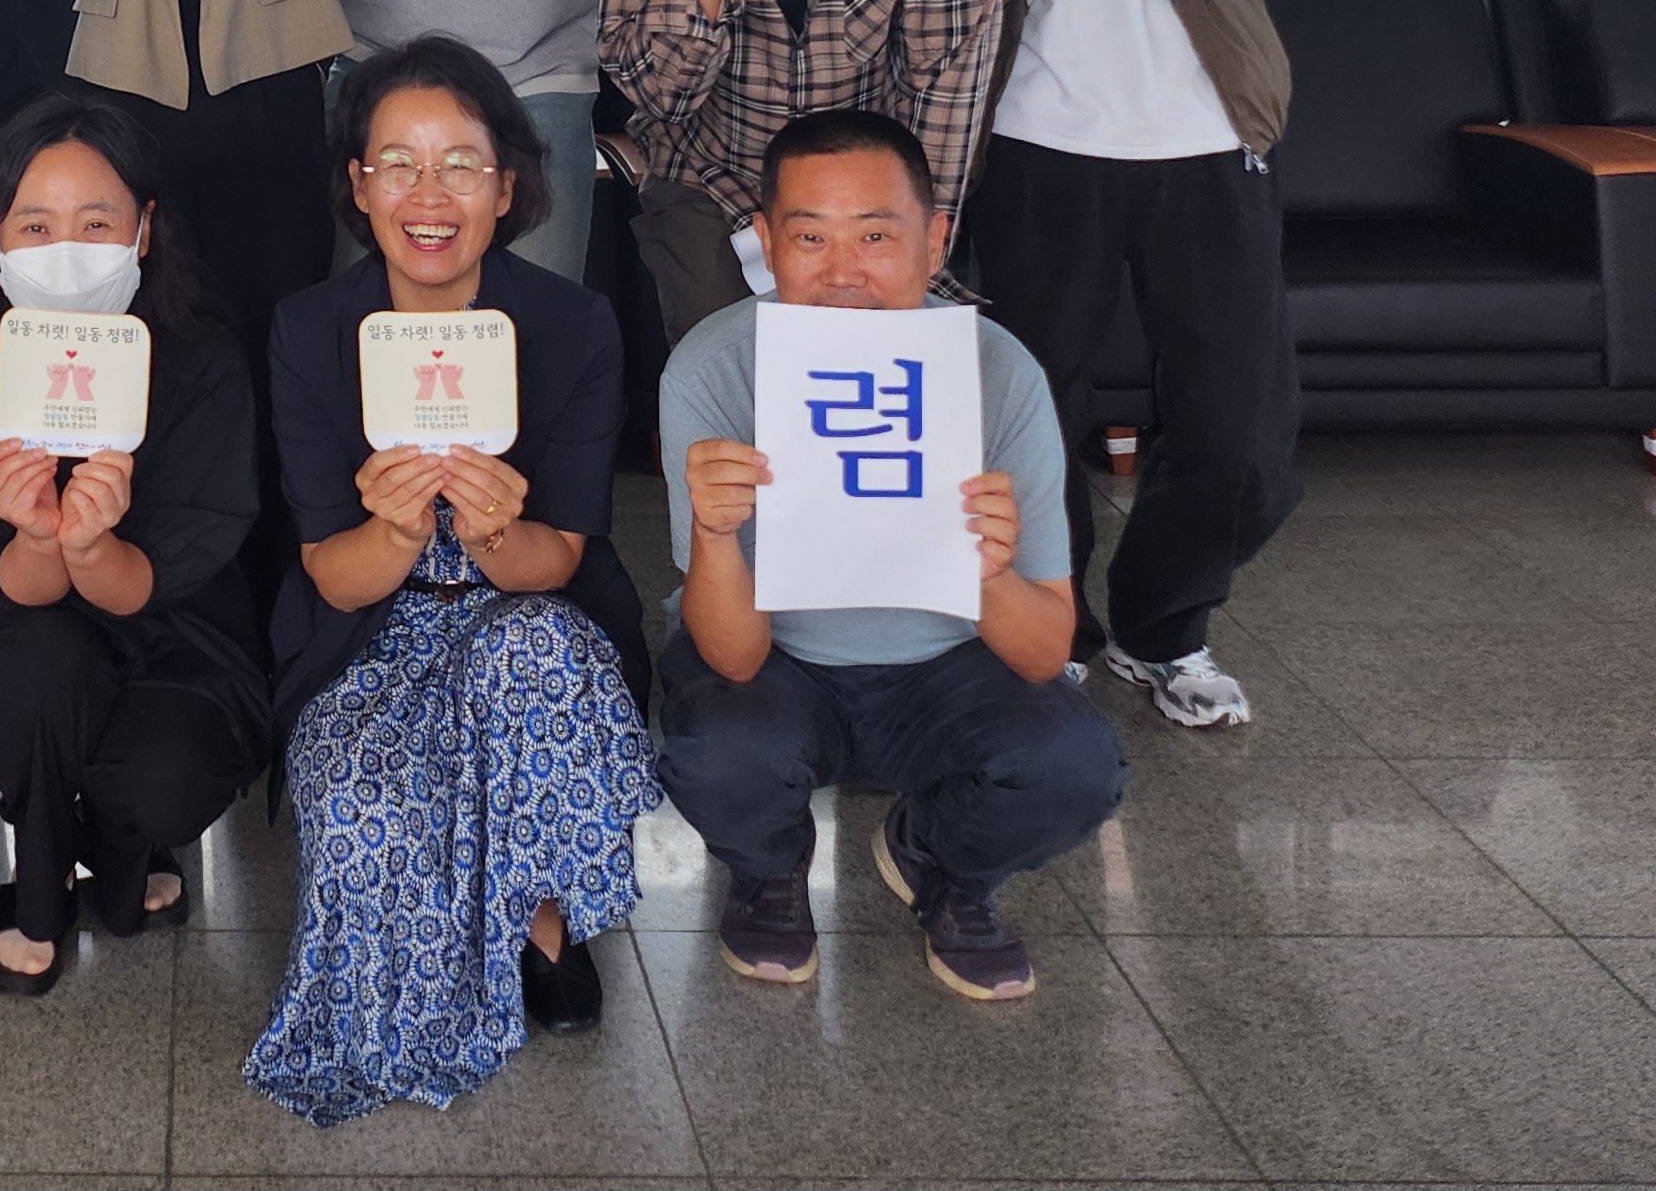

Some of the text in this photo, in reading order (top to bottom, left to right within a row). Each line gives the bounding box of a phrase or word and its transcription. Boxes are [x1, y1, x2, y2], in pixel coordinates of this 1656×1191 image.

[8, 320, 138, 343] 일동 차렷! 일동 청렴!
[368, 322, 504, 340] 일동 차렷! 일동 청렴!
[804, 358, 923, 499] 렴
